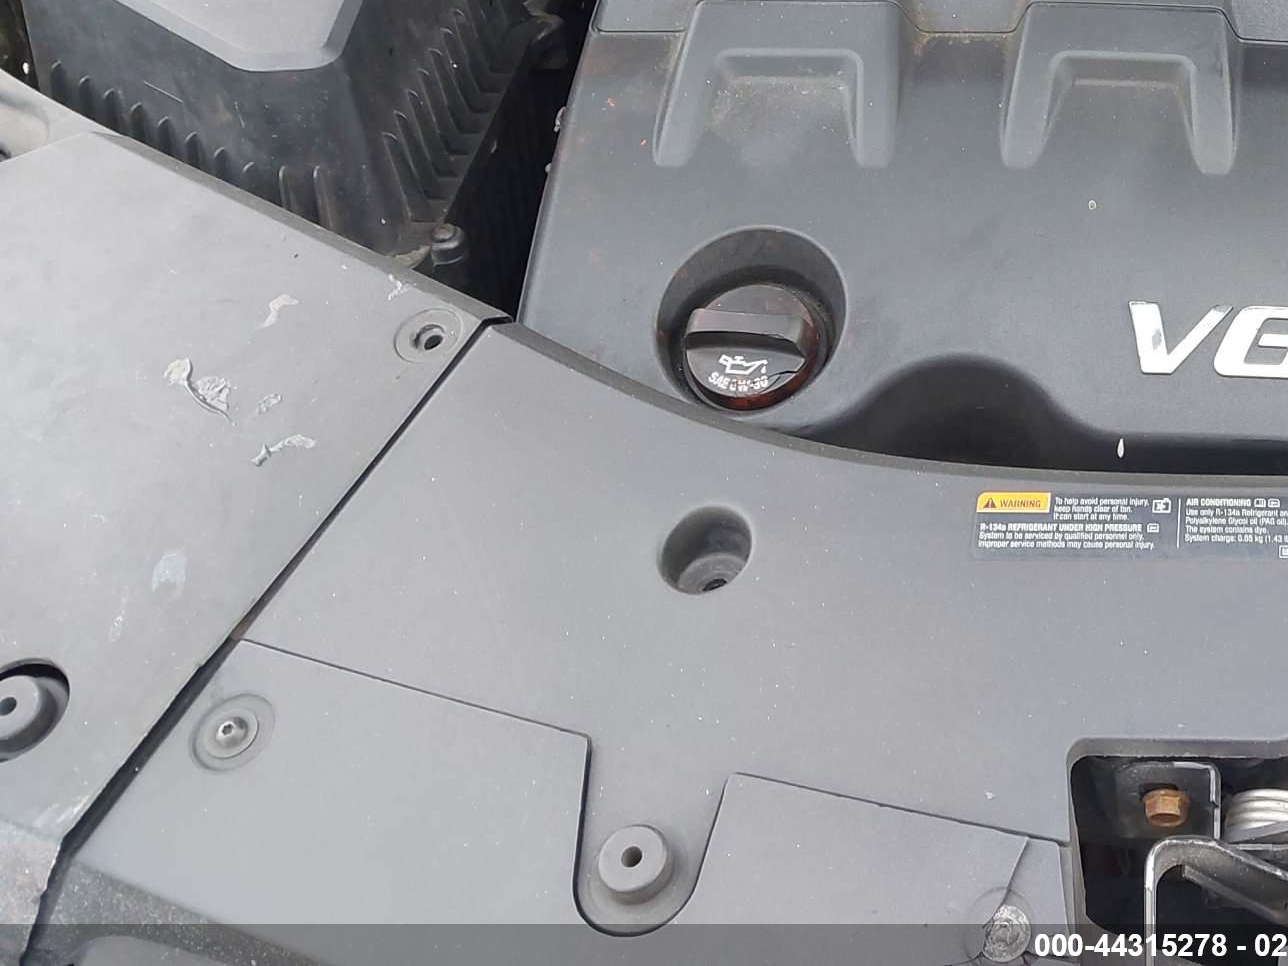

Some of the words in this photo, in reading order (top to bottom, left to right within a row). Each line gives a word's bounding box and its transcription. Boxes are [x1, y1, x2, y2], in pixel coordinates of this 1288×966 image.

[708, 372, 730, 389] SAE
[1000, 499, 1041, 508] WARNING
[1055, 497, 1063, 505] To
[1064, 497, 1079, 507] help
[1079, 497, 1098, 506] avoid
[1099, 498, 1128, 507] personal
[1186, 498, 1199, 506] AIR
[1200, 498, 1251, 507] CONDITIONING
[1054, 505, 1070, 514] keep
[1072, 505, 1093, 514] hands
[1094, 505, 1111, 513] clear
[1185, 508, 1198, 516] Use
[1200, 508, 1214, 518] only
[1241, 509, 1278, 518] Refrigerant
[1059, 513, 1072, 521] can
[1098, 514, 1111, 522] any
[1185, 517, 1226, 526] Polyalkylene
[1228, 517, 1248, 526] Glycol
[1250, 517, 1258, 525] oil
[1259, 517, 1275, 526] (PAG
[980, 523, 1007, 532] R-134a
[1008, 523, 1058, 532] REFRIGERANT
[1058, 523, 1084, 532] UNDER
[1104, 523, 1142, 532] PRESSURE
[1186, 525, 1198, 533] The
[1199, 526, 1223, 535] system
[1225, 526, 1253, 534] contains
[979, 532, 1004, 540] System
[1024, 532, 1053, 540] serviced
[1054, 532, 1063, 541] by
[1064, 532, 1092, 541] qualified
[1094, 533, 1127, 541] personnel
[1185, 534, 1209, 543] System
[1211, 534, 1236, 544] charge:
[1254, 535, 1263, 544] kg
[978, 540, 1008, 549] Improper
[1036, 540, 1065, 548] methods
[1104, 541, 1133, 550] personal
